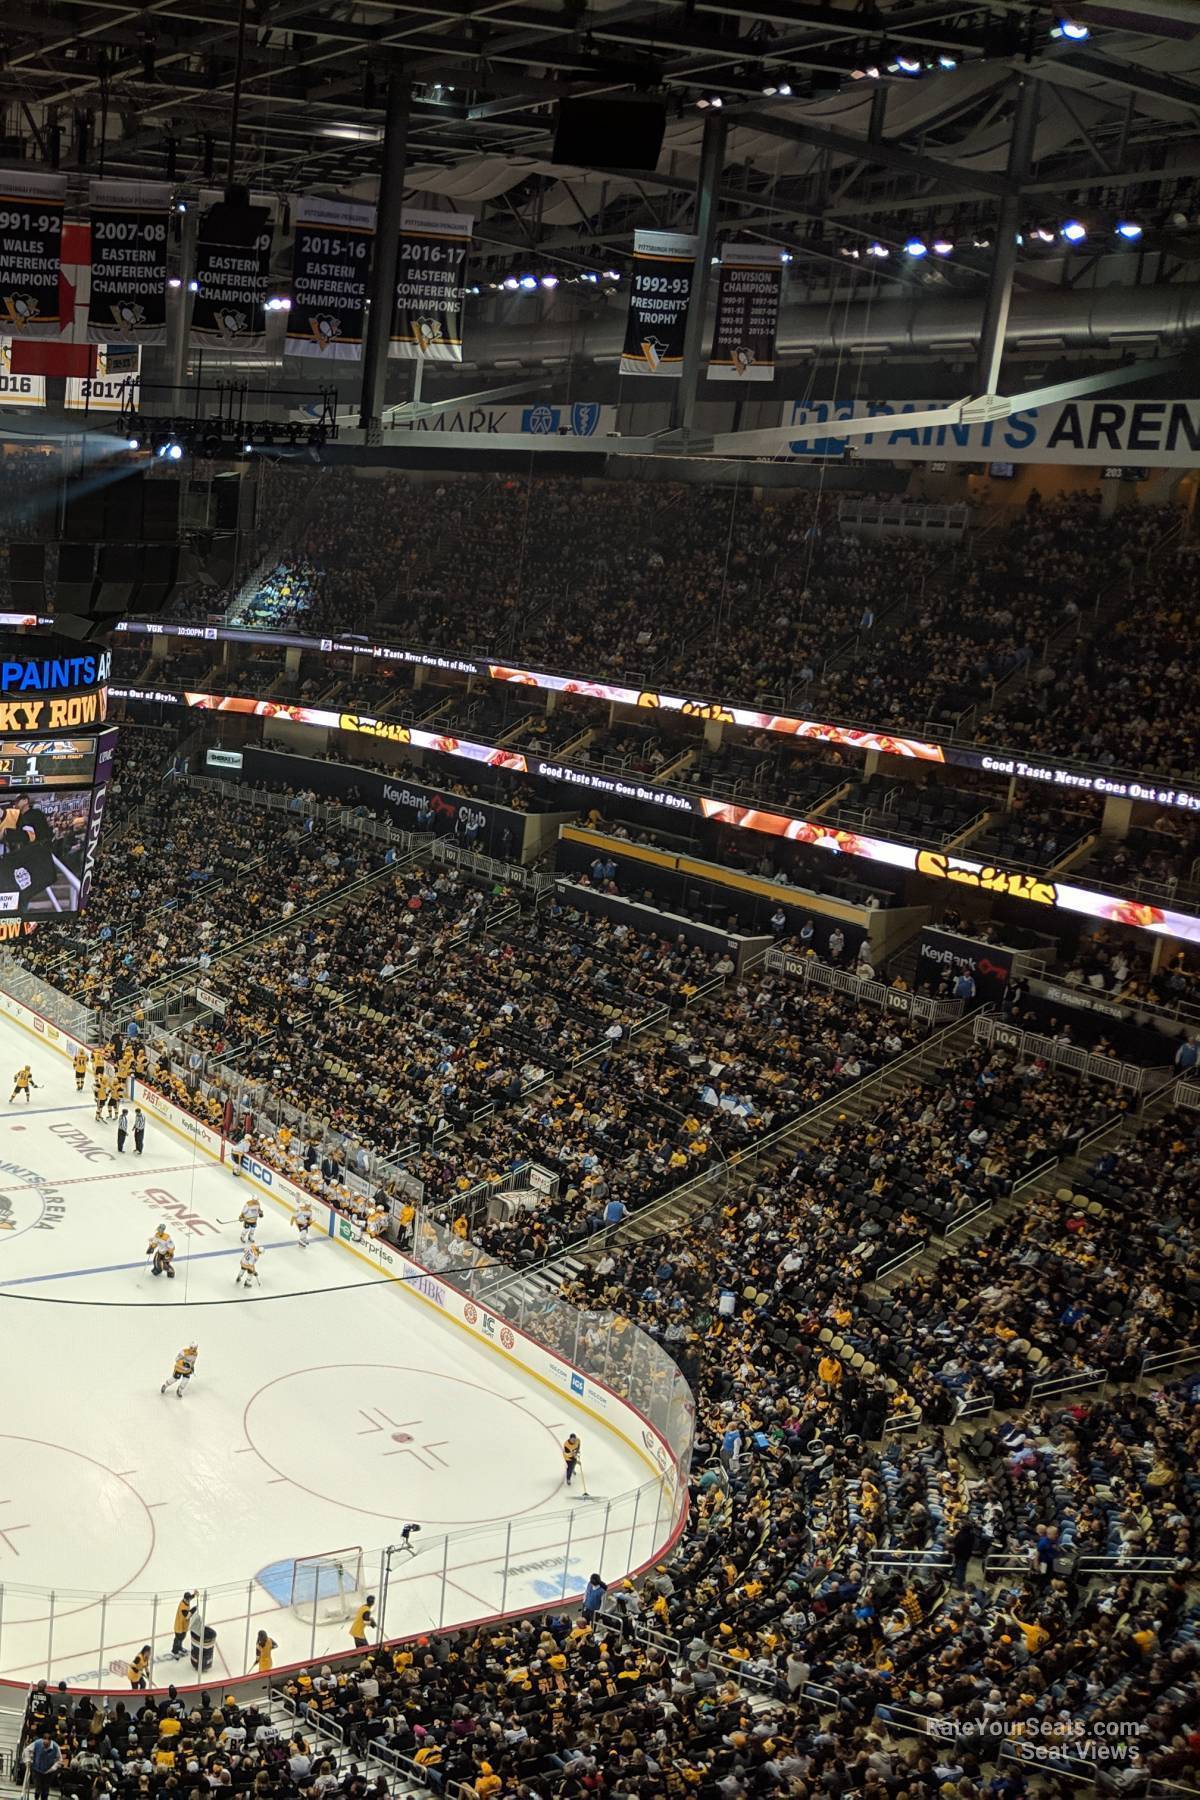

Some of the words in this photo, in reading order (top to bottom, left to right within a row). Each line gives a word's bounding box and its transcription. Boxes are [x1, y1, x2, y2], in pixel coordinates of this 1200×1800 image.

[95, 222, 166, 242] 2007-08
[3, 238, 44, 254] WALES
[302, 235, 366, 259] 2015-16
[401, 243, 466, 265] 2016-17
[102, 248, 156, 263] EASTERN
[209, 255, 260, 272] EASTERN
[91, 262, 167, 278] CONFERENCE
[198, 270, 269, 288] CONFERENCE
[306, 262, 356, 279] EASTERN
[407, 268, 456, 284] EASTERN
[731, 271, 772, 283] DIVISION
[92, 279, 165, 295] CHAMPIONS
[294, 276, 365, 295] CONFERENCE
[397, 283, 465, 299] CONFERENCE
[635, 274, 689, 294] 1992-93
[723, 282, 779, 295] CHAMPIONS
[199, 287, 266, 304] CHAMPIONS
[296, 293, 362, 310] CHAMPIONS
[631, 296, 690, 311] PRESIDENTS'
[397, 298, 461, 314] CHAMPIONS
[639, 311, 678, 325] TROPHY
[81, 380, 124, 398] 2017
[1105, 467, 1122, 477] 203
[146, 624, 163, 633] VGK
[178, 627, 204, 637] 10:00PM
[2, 656, 96, 690] PAINTS
[108, 688, 128, 697] Goes
[130, 690, 143, 699] Out
[47, 698, 98, 731] ROW
[26, 756, 39, 776] 1
[539, 763, 563, 779] Good
[564, 769, 590, 785] Taste
[592, 776, 615, 791] Never
[616, 782, 636, 796] Goes
[637, 787, 653, 800] Out
[654, 793, 664, 803] of
[665, 794, 693, 810] Style.
[982, 757, 1014, 773] Good
[1017, 763, 1052, 780] Taste
[1055, 771, 1092, 788] Never
[1095, 778, 1126, 795] Goes
[1130, 784, 1156, 800] Out
[1159, 791, 1174, 803] of
[383, 784, 430, 810] KeyBank
[458, 806, 487, 828] Club
[81, 786, 107, 899] UPMC
[915, 850, 1058, 905] Smith's
[921, 943, 976, 972] KeyBank
[785, 962, 805, 976] 103
[888, 993, 908, 1011] 103
[1093, 1003, 1122, 1019] ARENA
[996, 1030, 1017, 1048] 104
[48, 1122, 117, 1165] UPMC
[240, 1153, 272, 1186] EICO
[32, 1188, 67, 1231] ARENA
[144, 1188, 221, 1237] GNC
[418, 1278, 446, 1307] HBK
[571, 1376, 583, 1391] IGS
